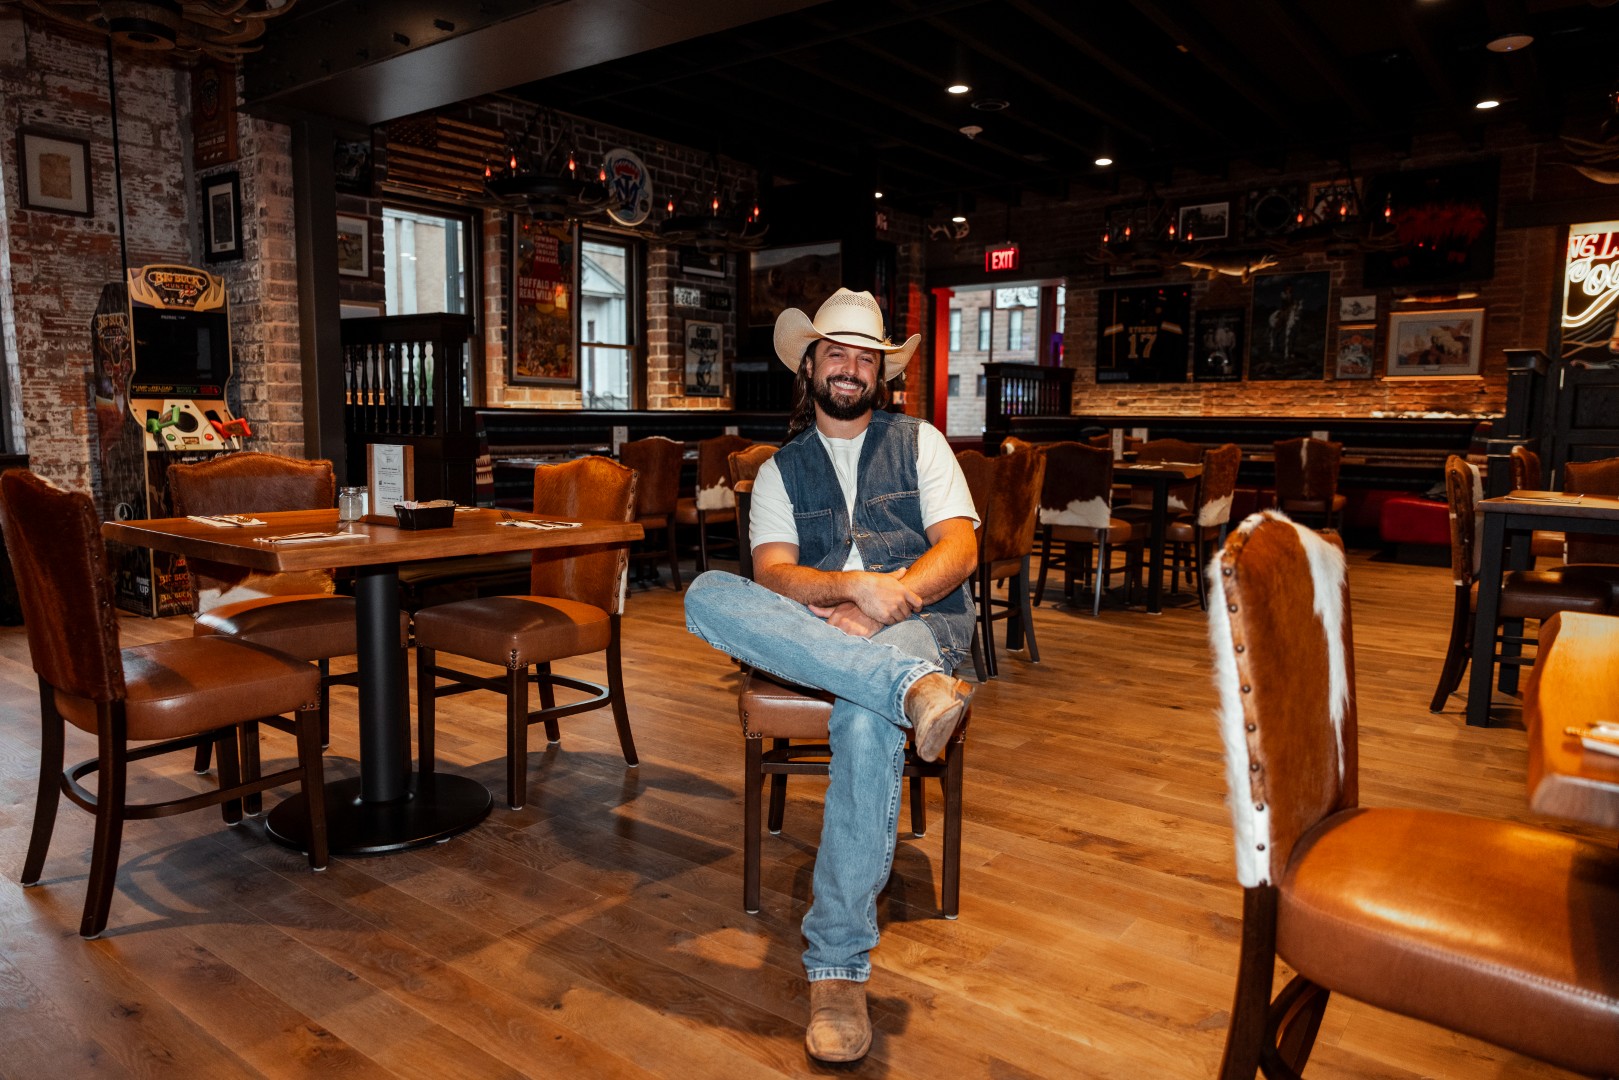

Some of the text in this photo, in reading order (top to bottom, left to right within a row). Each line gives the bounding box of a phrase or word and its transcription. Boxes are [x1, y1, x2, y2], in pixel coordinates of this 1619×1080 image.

[992, 250, 1015, 270] EXIT
[154, 272, 202, 290] BIG BUCK
[518, 276, 550, 290] BUFFALO
[518, 287, 535, 299] REAL
[536, 289, 553, 301] WILD
[1127, 333, 1158, 359] 17
